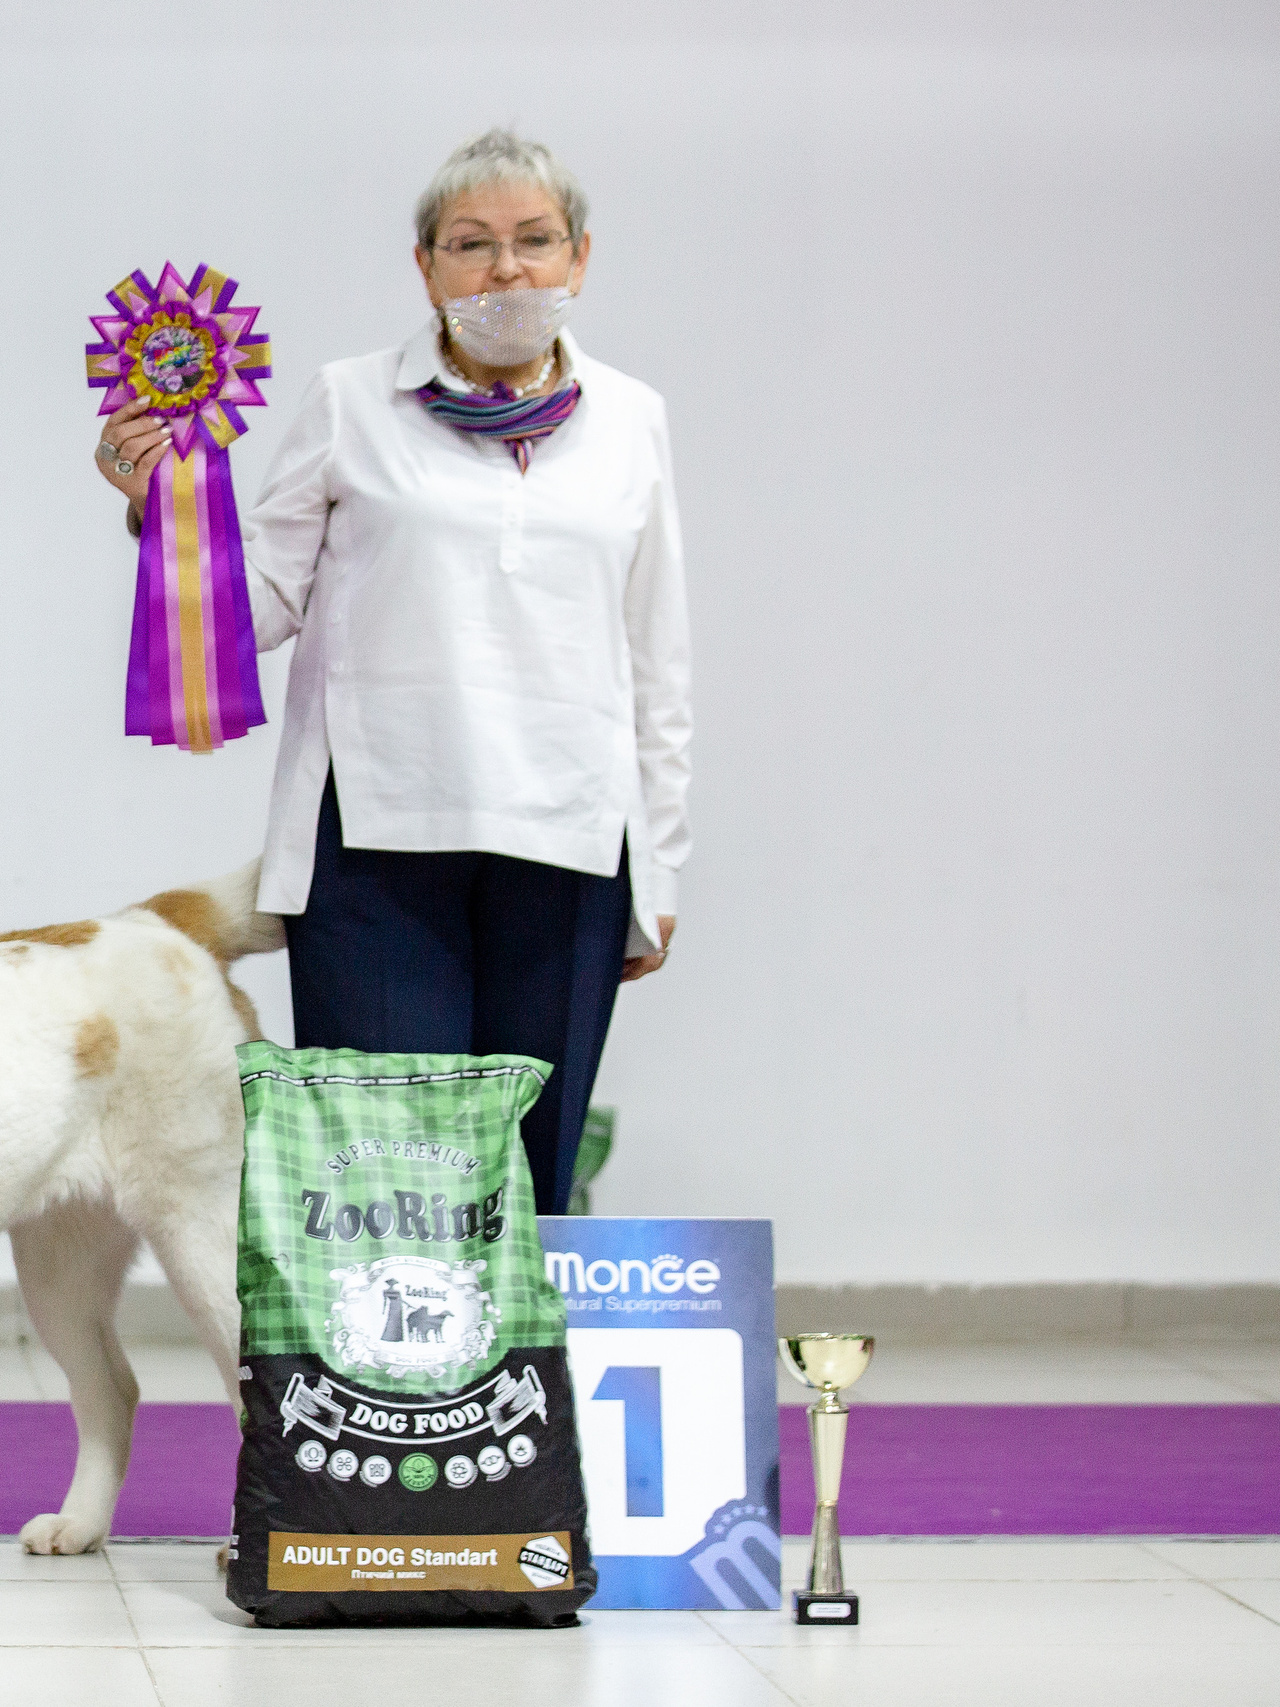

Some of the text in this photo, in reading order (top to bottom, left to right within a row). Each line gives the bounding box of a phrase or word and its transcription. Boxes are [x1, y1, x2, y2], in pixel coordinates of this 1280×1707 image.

[327, 1138, 481, 1175] SUPER PREMIUM
[301, 1187, 508, 1243] ZooRing
[605, 1295, 723, 1315] Superpremium
[349, 1401, 484, 1435] DOG FOOD
[591, 1365, 665, 1518] 1
[282, 1546, 498, 1567] ADULT DOG Standart
